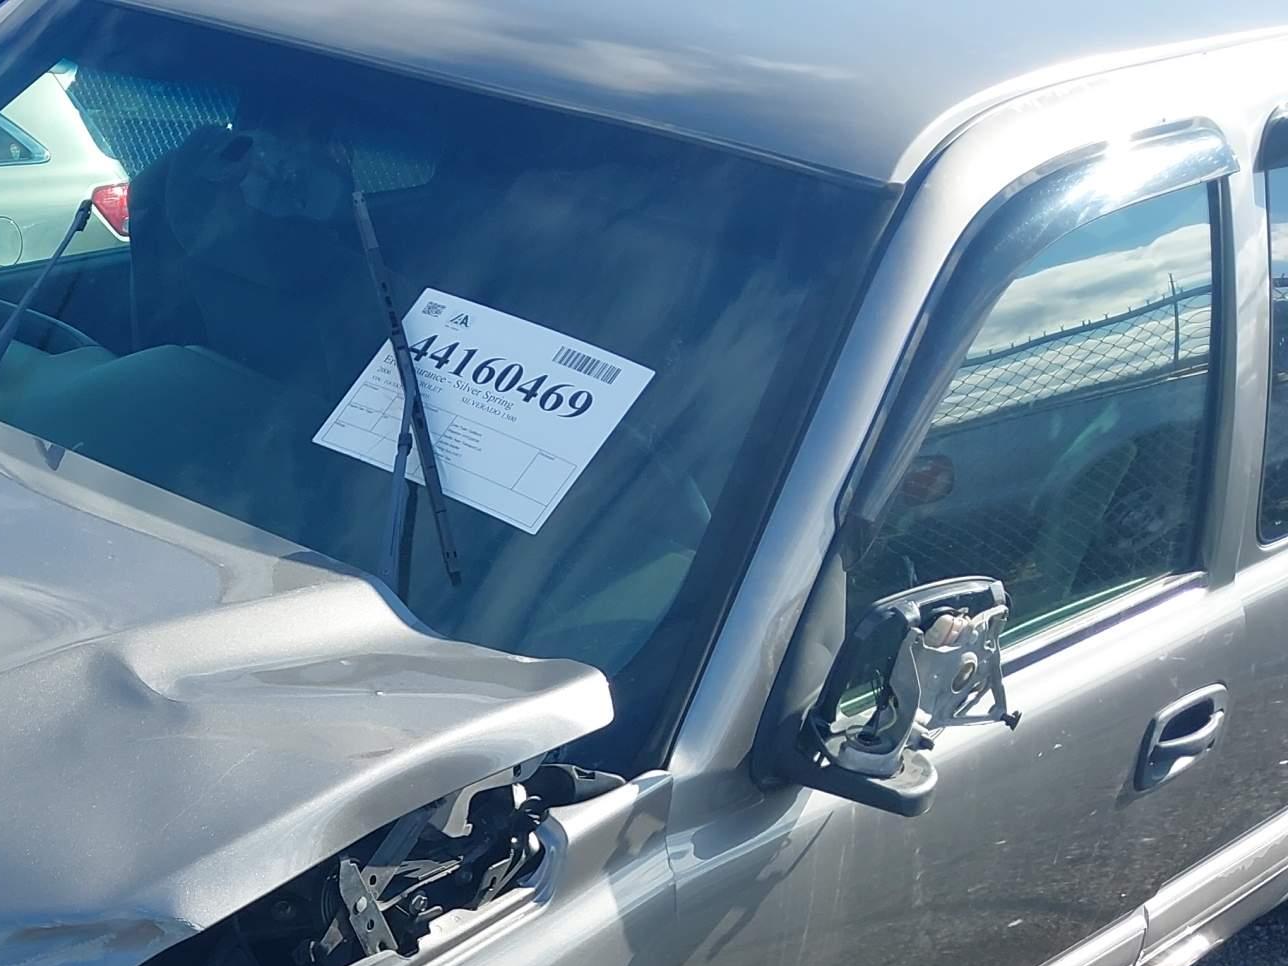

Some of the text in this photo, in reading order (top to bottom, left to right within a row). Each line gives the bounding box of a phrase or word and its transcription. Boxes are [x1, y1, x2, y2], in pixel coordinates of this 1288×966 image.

[408, 334, 594, 418] 44160469
[453, 380, 482, 397] Silver
[482, 390, 515, 411] Spring
